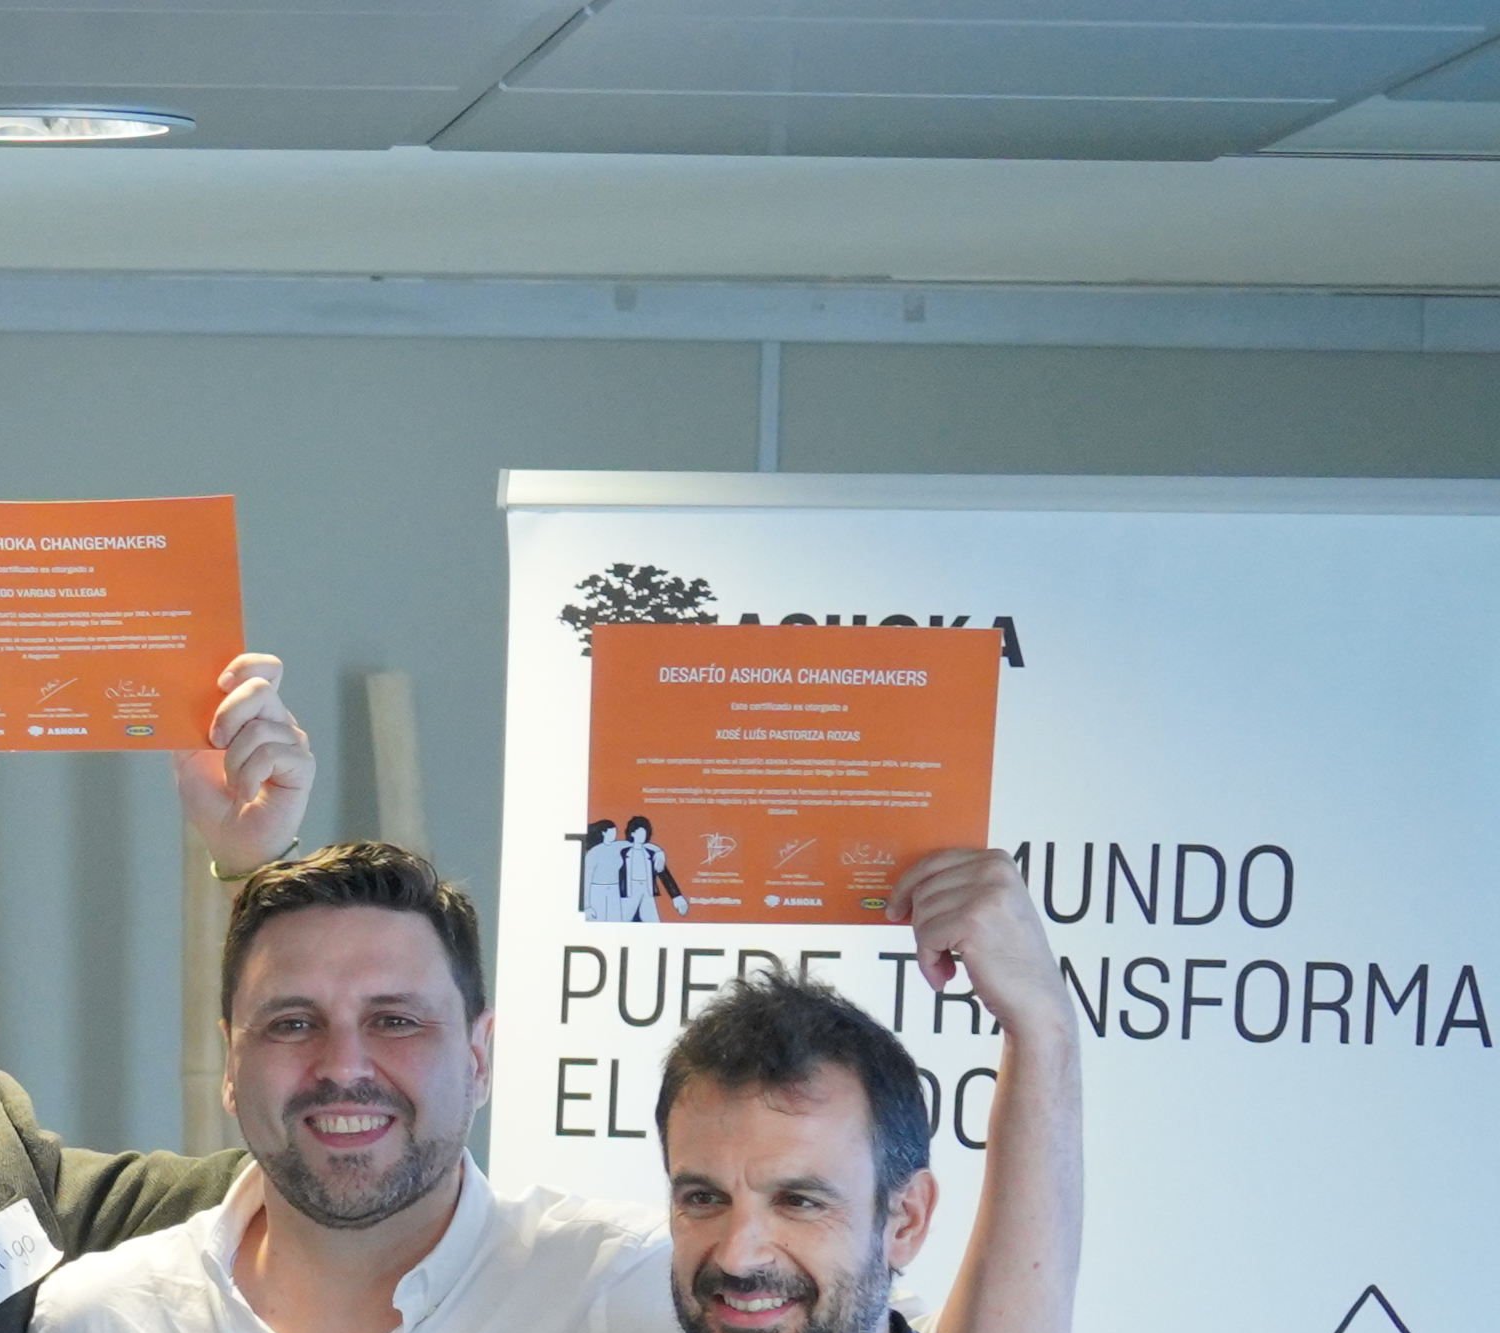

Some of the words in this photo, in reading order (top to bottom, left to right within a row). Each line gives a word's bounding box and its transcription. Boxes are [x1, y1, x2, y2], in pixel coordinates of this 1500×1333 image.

[40, 535, 167, 550] CHANGEMAKERS
[659, 663, 726, 684] DESAFÍO
[729, 667, 793, 684] ASHOKA
[797, 668, 928, 687] CHANGEMAKERS
[47, 727, 88, 735] ASHOKA
[783, 898, 823, 906] ASHOKA
[878, 950, 1494, 1048] TRNSFORMA
[555, 1057, 647, 1139] EL
